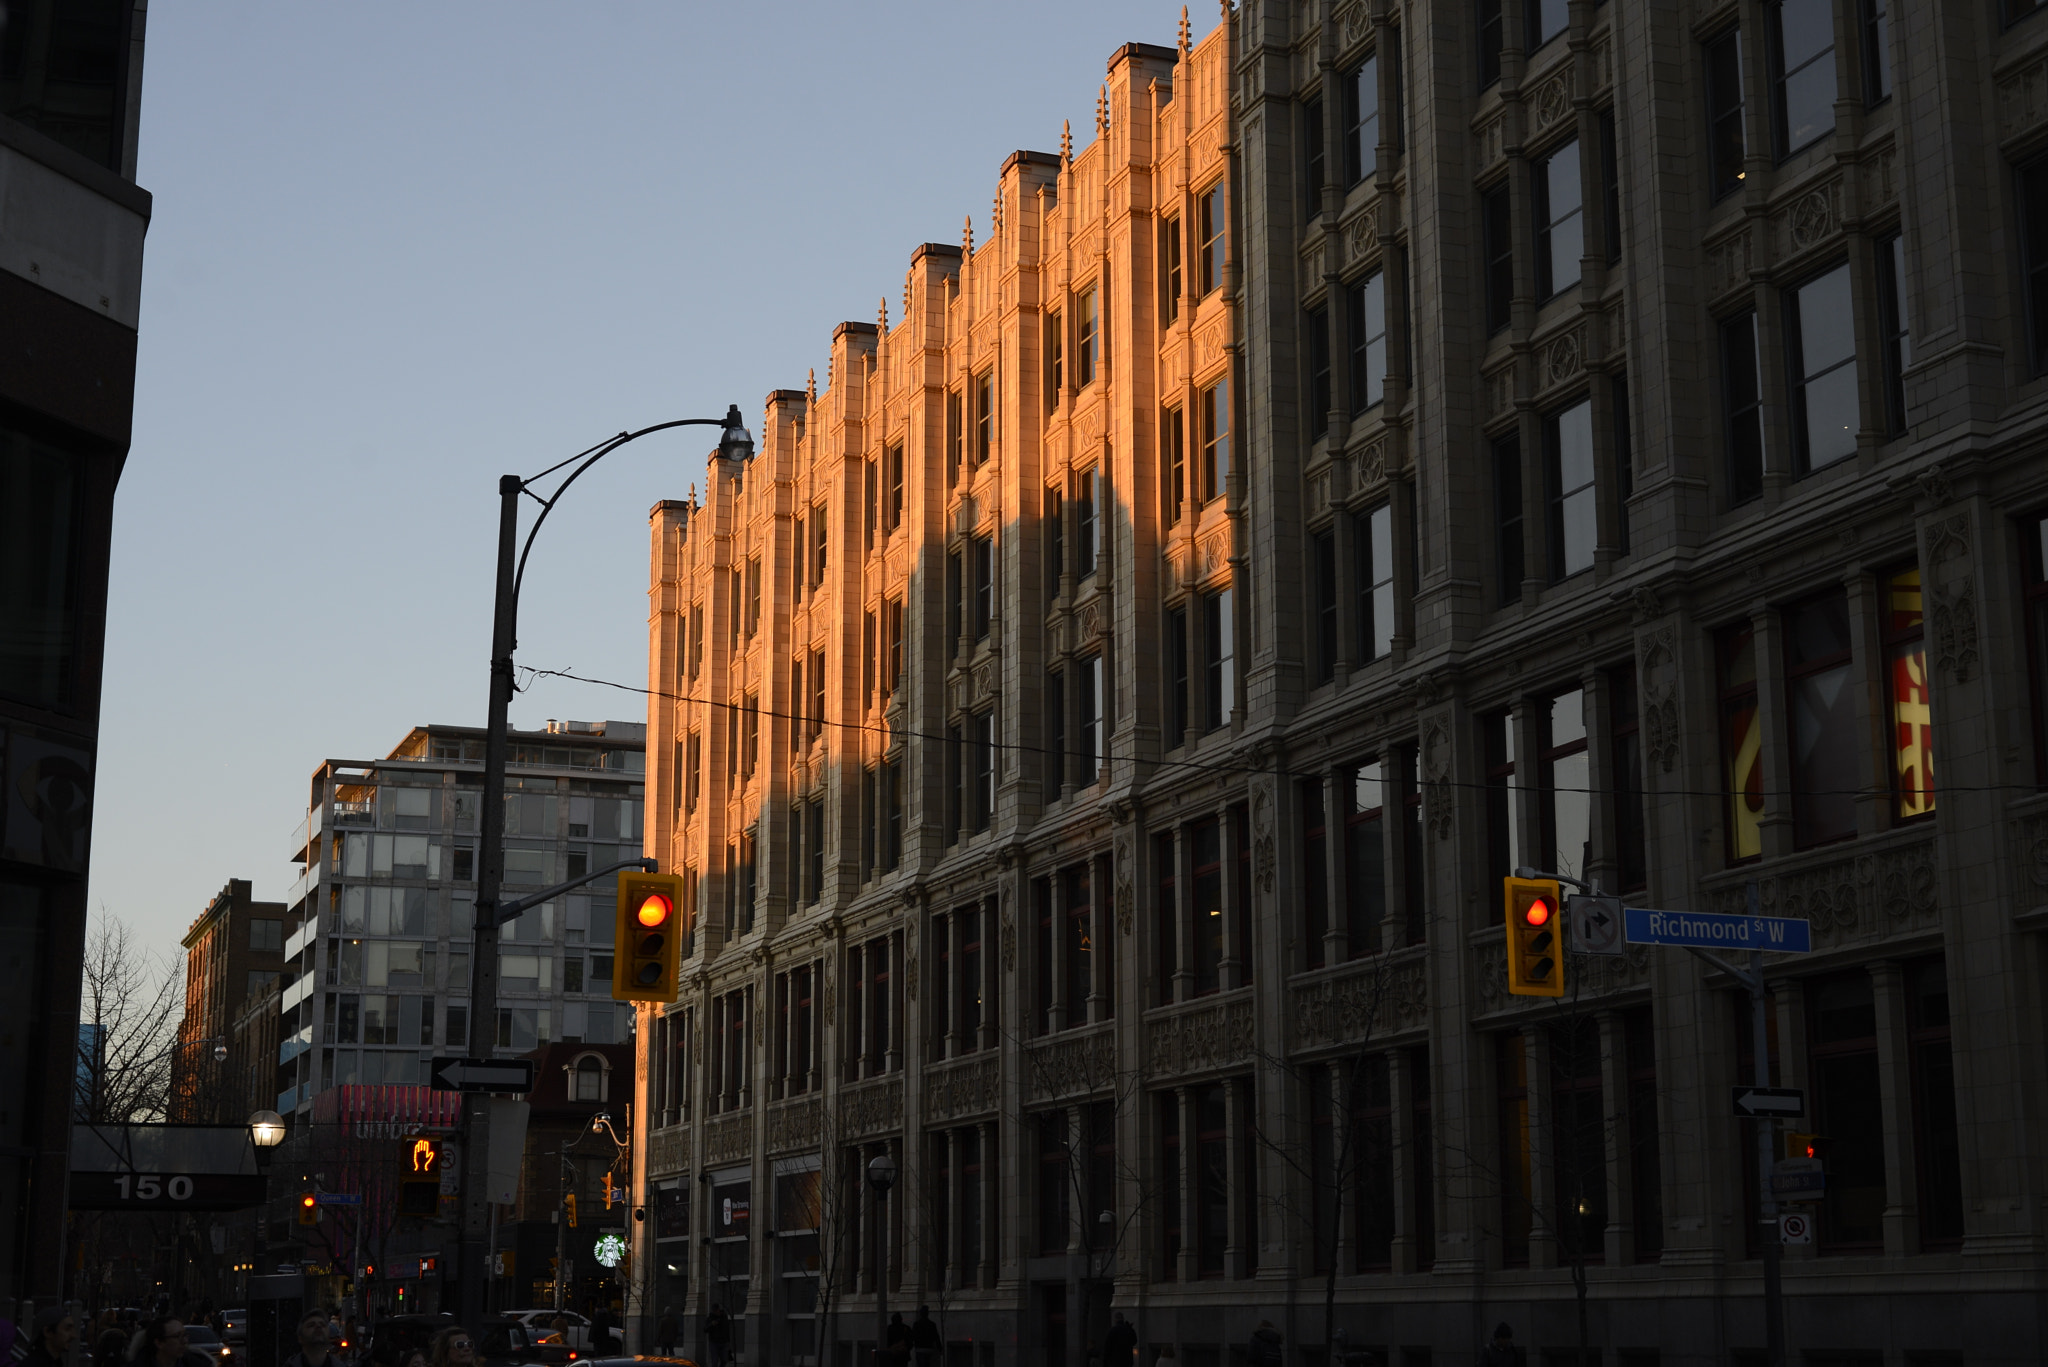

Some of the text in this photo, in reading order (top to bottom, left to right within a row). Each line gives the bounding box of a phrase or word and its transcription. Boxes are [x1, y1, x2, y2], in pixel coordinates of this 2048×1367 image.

[1650, 914, 1785, 943] Richmond St W
[113, 1175, 194, 1201] 150
[1781, 1175, 1800, 1189] John
